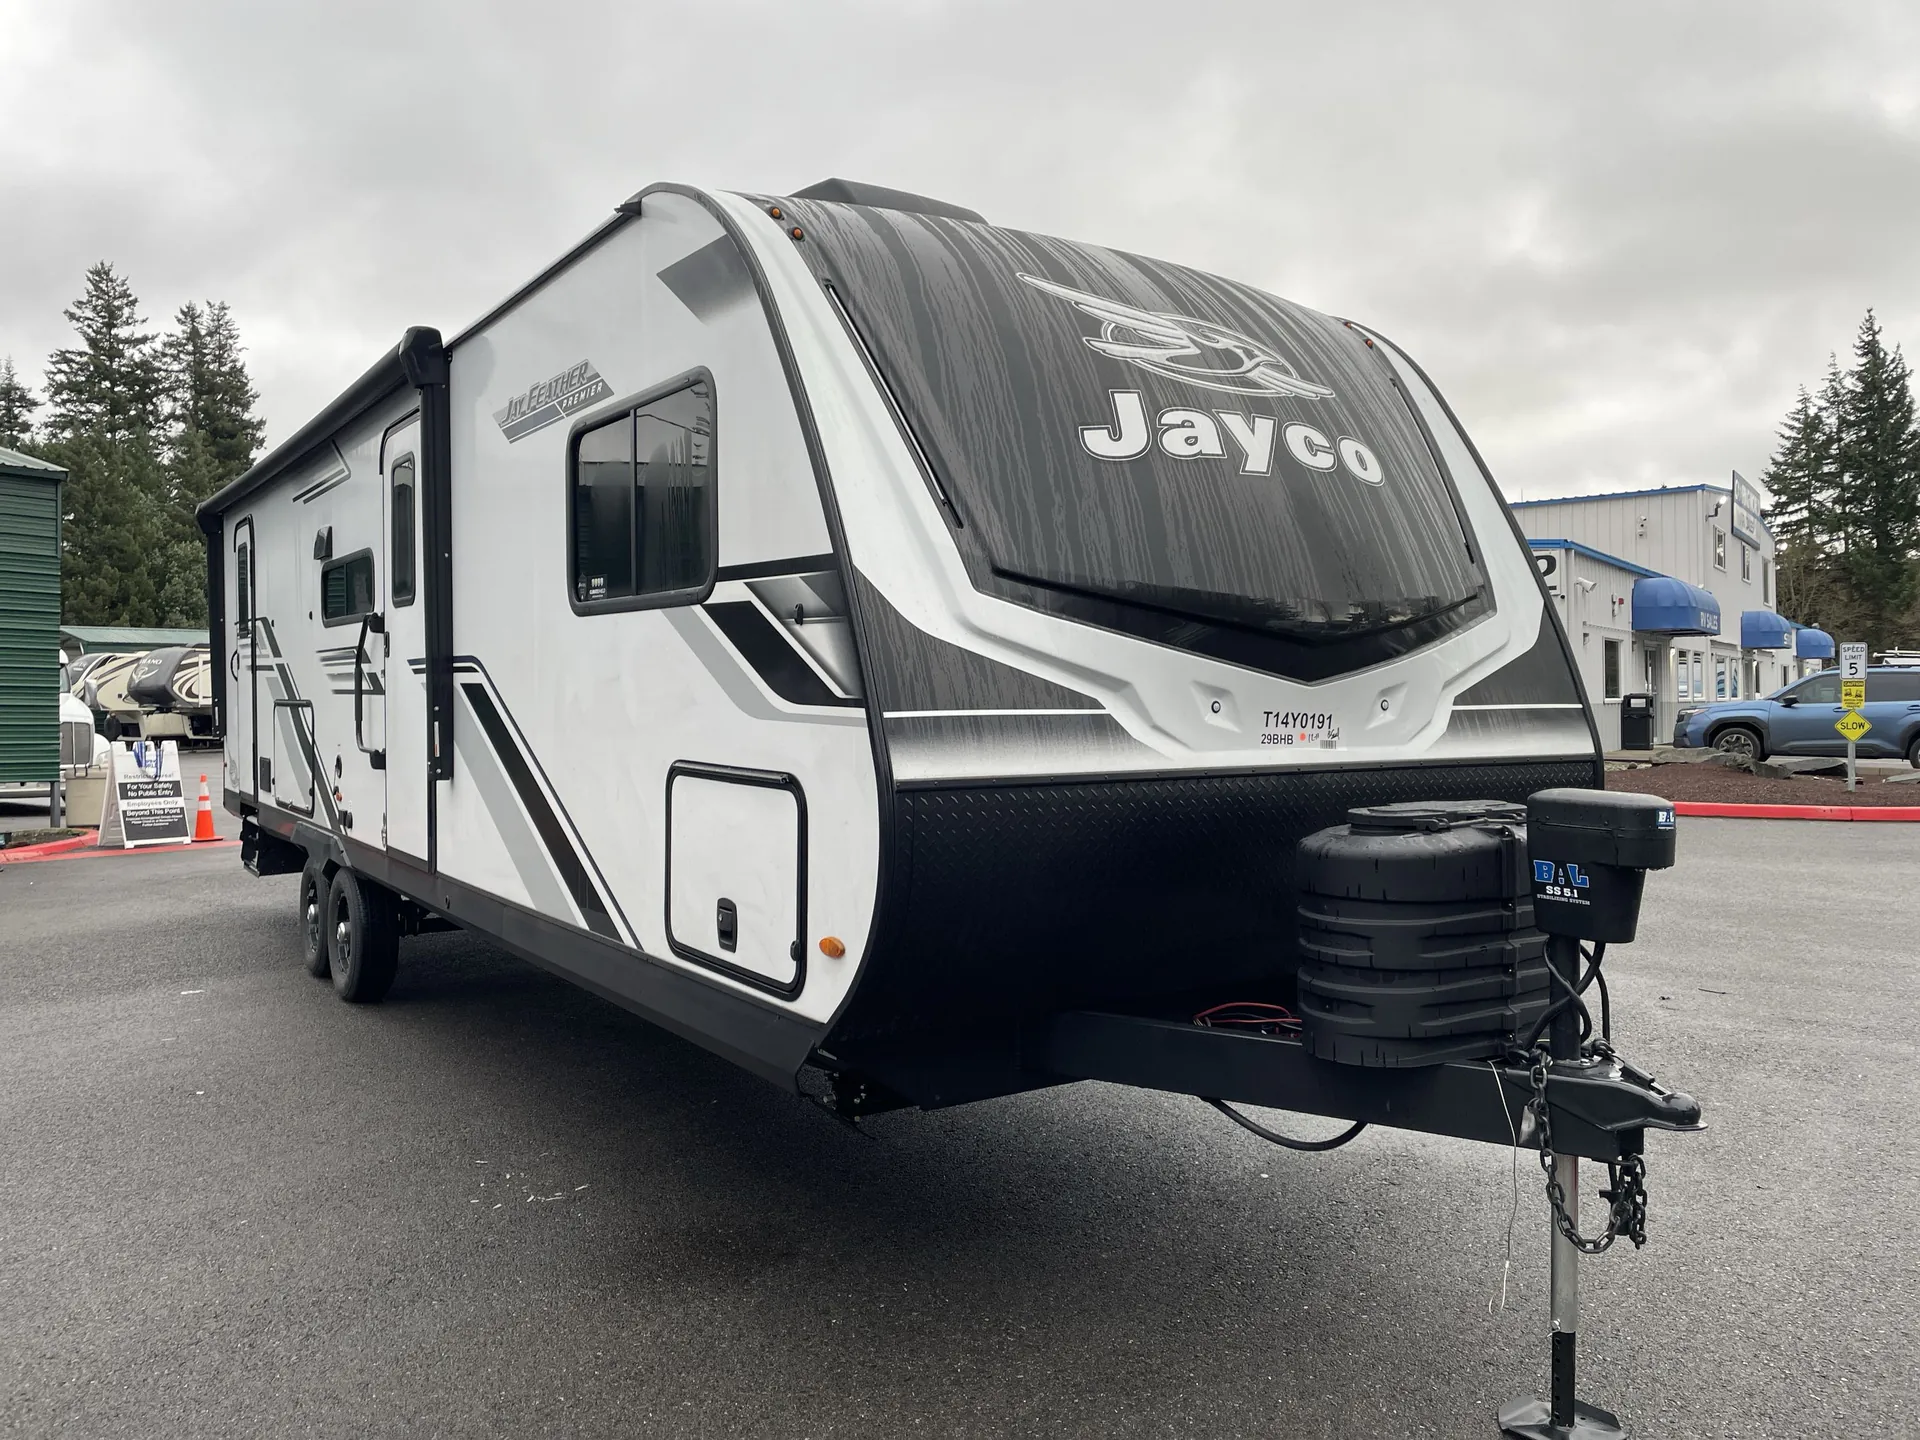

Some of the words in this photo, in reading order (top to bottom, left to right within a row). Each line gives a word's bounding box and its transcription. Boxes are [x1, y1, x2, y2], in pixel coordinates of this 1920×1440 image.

[525, 359, 589, 413] FEATHER
[562, 382, 602, 410] PREMIER
[1078, 389, 1386, 487] Jayco
[1700, 611, 1707, 628] RV
[1849, 663, 1858, 675] 5
[1263, 711, 1333, 730] T14Y0191
[1840, 722, 1866, 730] SLOW
[1261, 733, 1294, 745] 29BHB
[1545, 885, 1562, 896] SS
[1563, 887, 1579, 898] 5.1
[1536, 893, 1569, 903] STABILIZING
[1569, 898, 1591, 906] SYSTEM
